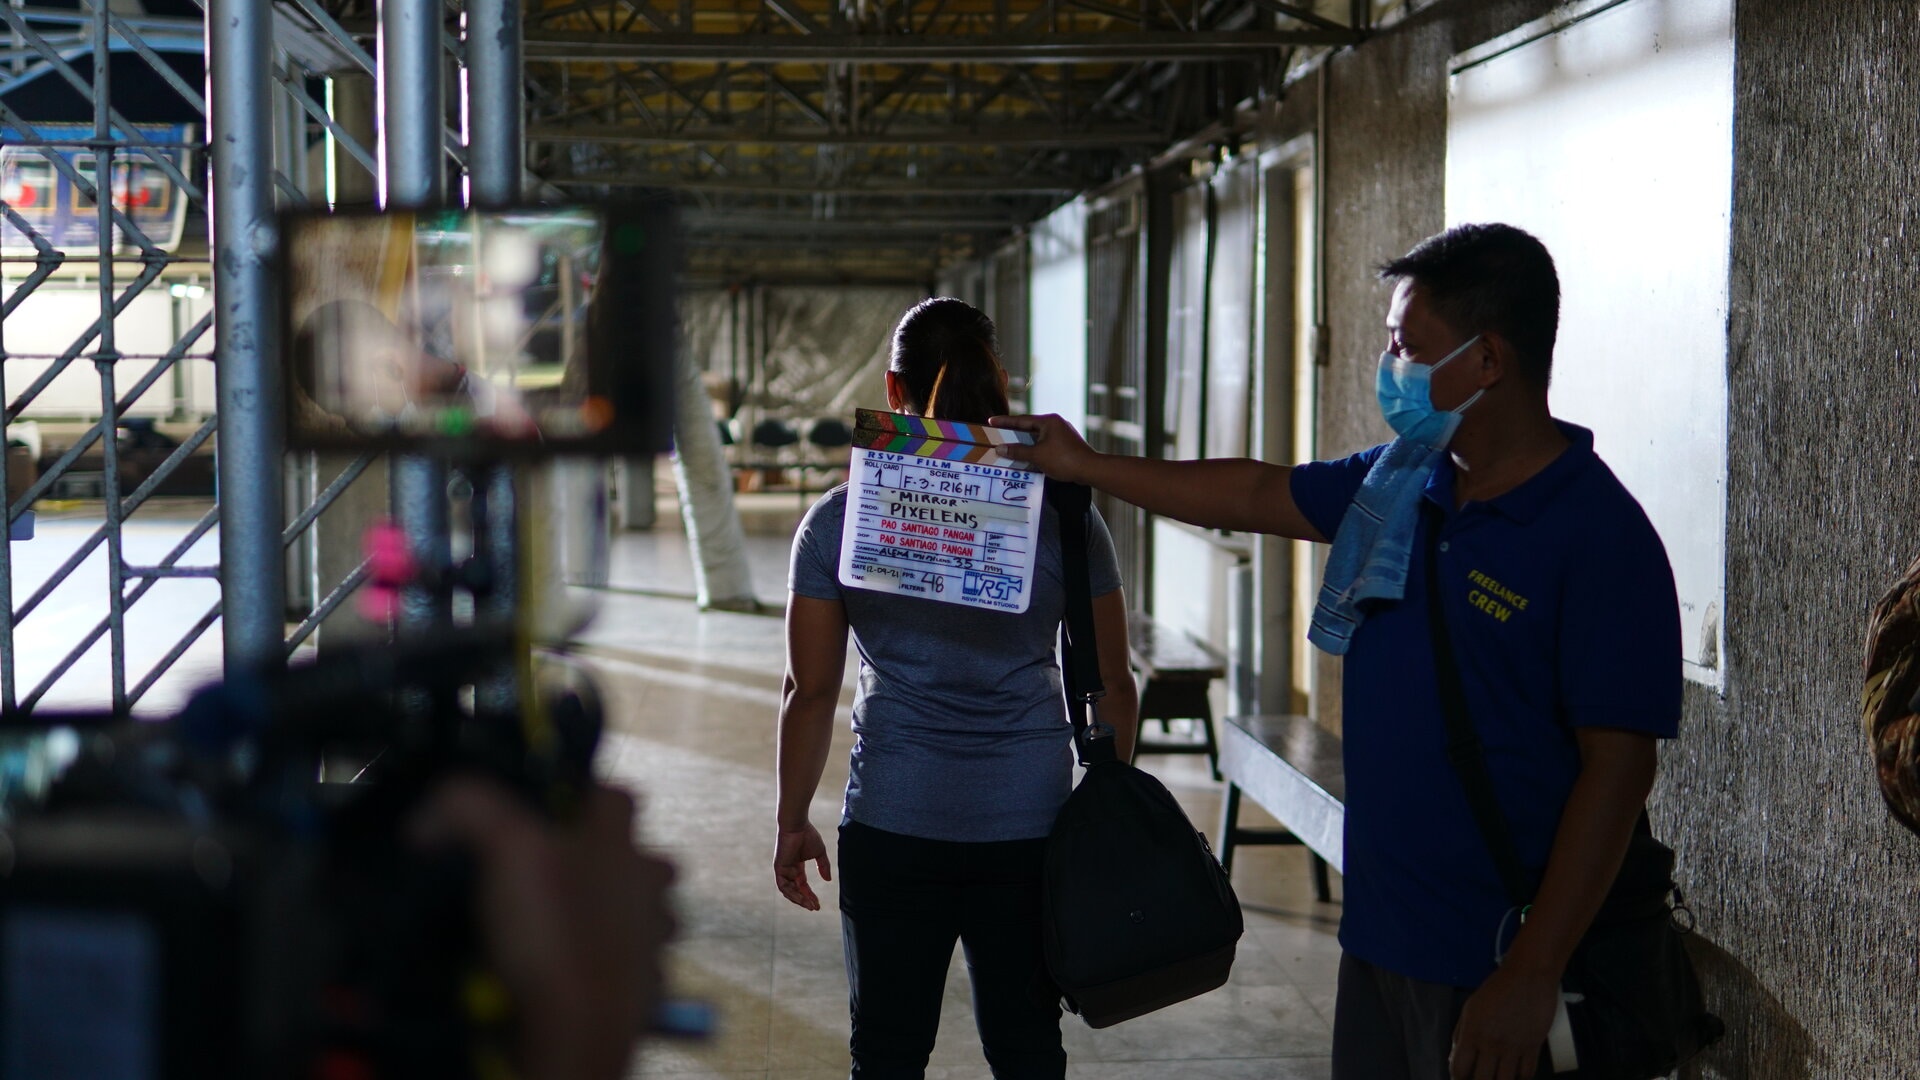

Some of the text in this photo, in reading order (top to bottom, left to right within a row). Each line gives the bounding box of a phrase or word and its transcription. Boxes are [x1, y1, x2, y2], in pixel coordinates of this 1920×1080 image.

[868, 451, 1030, 480] RSVP FILM STUDIOS
[929, 470, 960, 480] SCENE
[874, 469, 884, 487] 1
[1002, 480, 1026, 489] TAKE
[890, 502, 978, 529] PIXELENS
[881, 519, 897, 530] PAO
[901, 522, 940, 536] SANTIAGO
[943, 528, 975, 542] PANGAN
[879, 533, 974, 557] PAO SANTIAGO PANGAN
[953, 556, 973, 569] 35
[921, 571, 944, 593] 48
[1468, 569, 1529, 610] FREELANCE
[961, 595, 1019, 610] RSVP FILM STUDIOS
[1468, 590, 1512, 622] CREW
